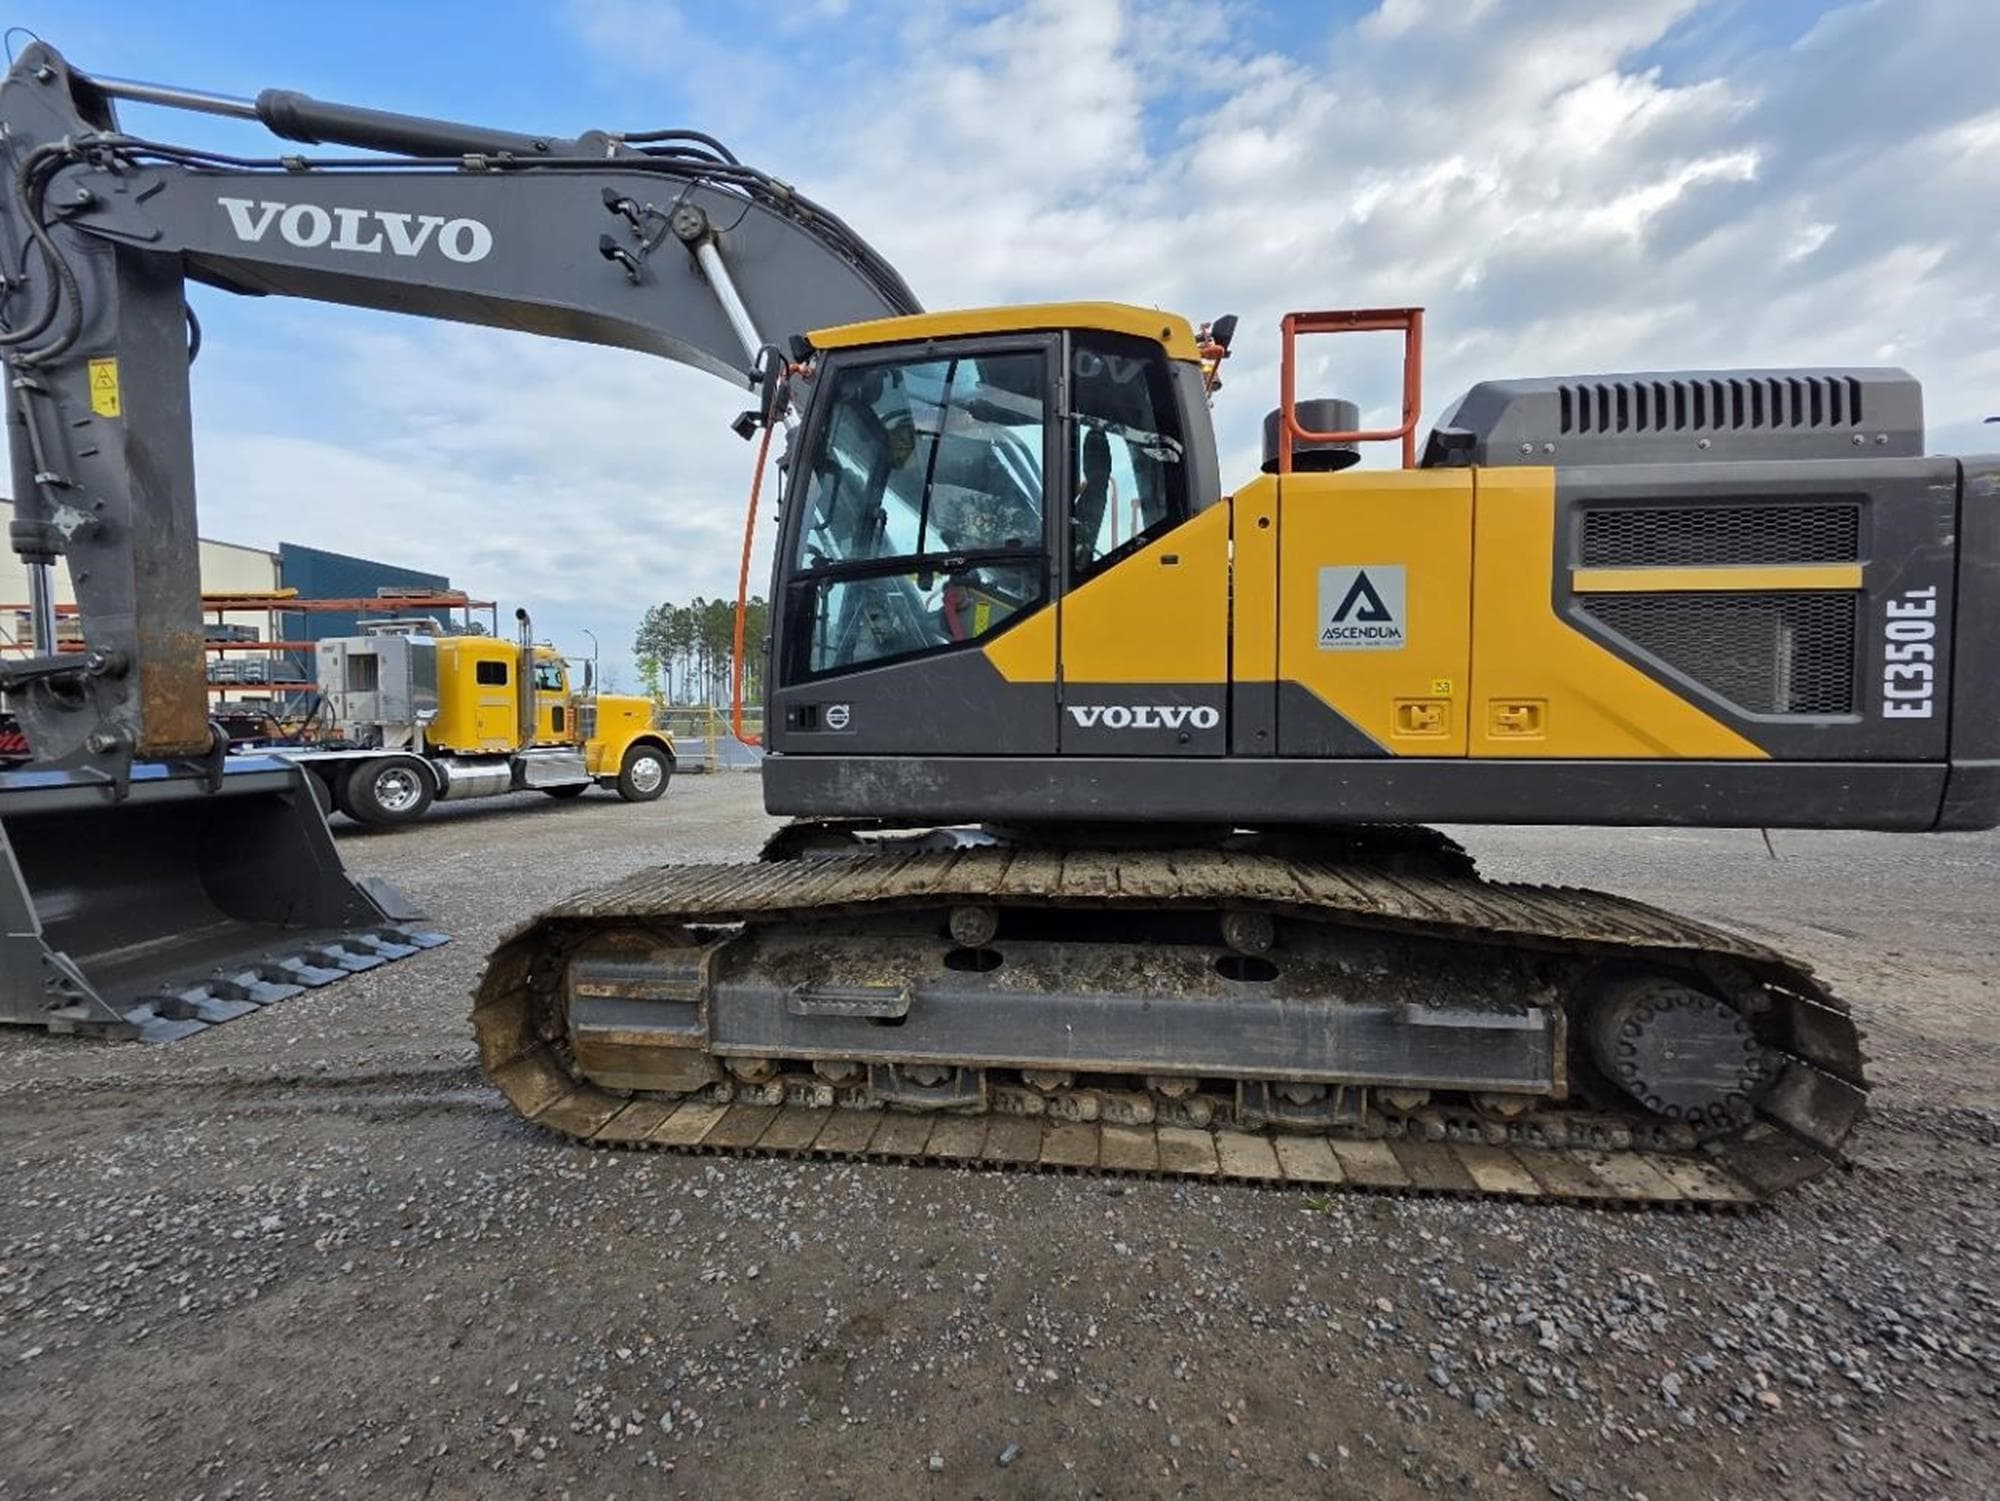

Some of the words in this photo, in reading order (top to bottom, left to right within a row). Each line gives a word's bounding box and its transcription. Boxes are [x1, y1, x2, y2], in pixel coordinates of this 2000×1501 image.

[217, 196, 494, 264] VOLVO
[1321, 627, 1402, 640] ASCENDUM
[1067, 705, 1220, 730] VOLVO
